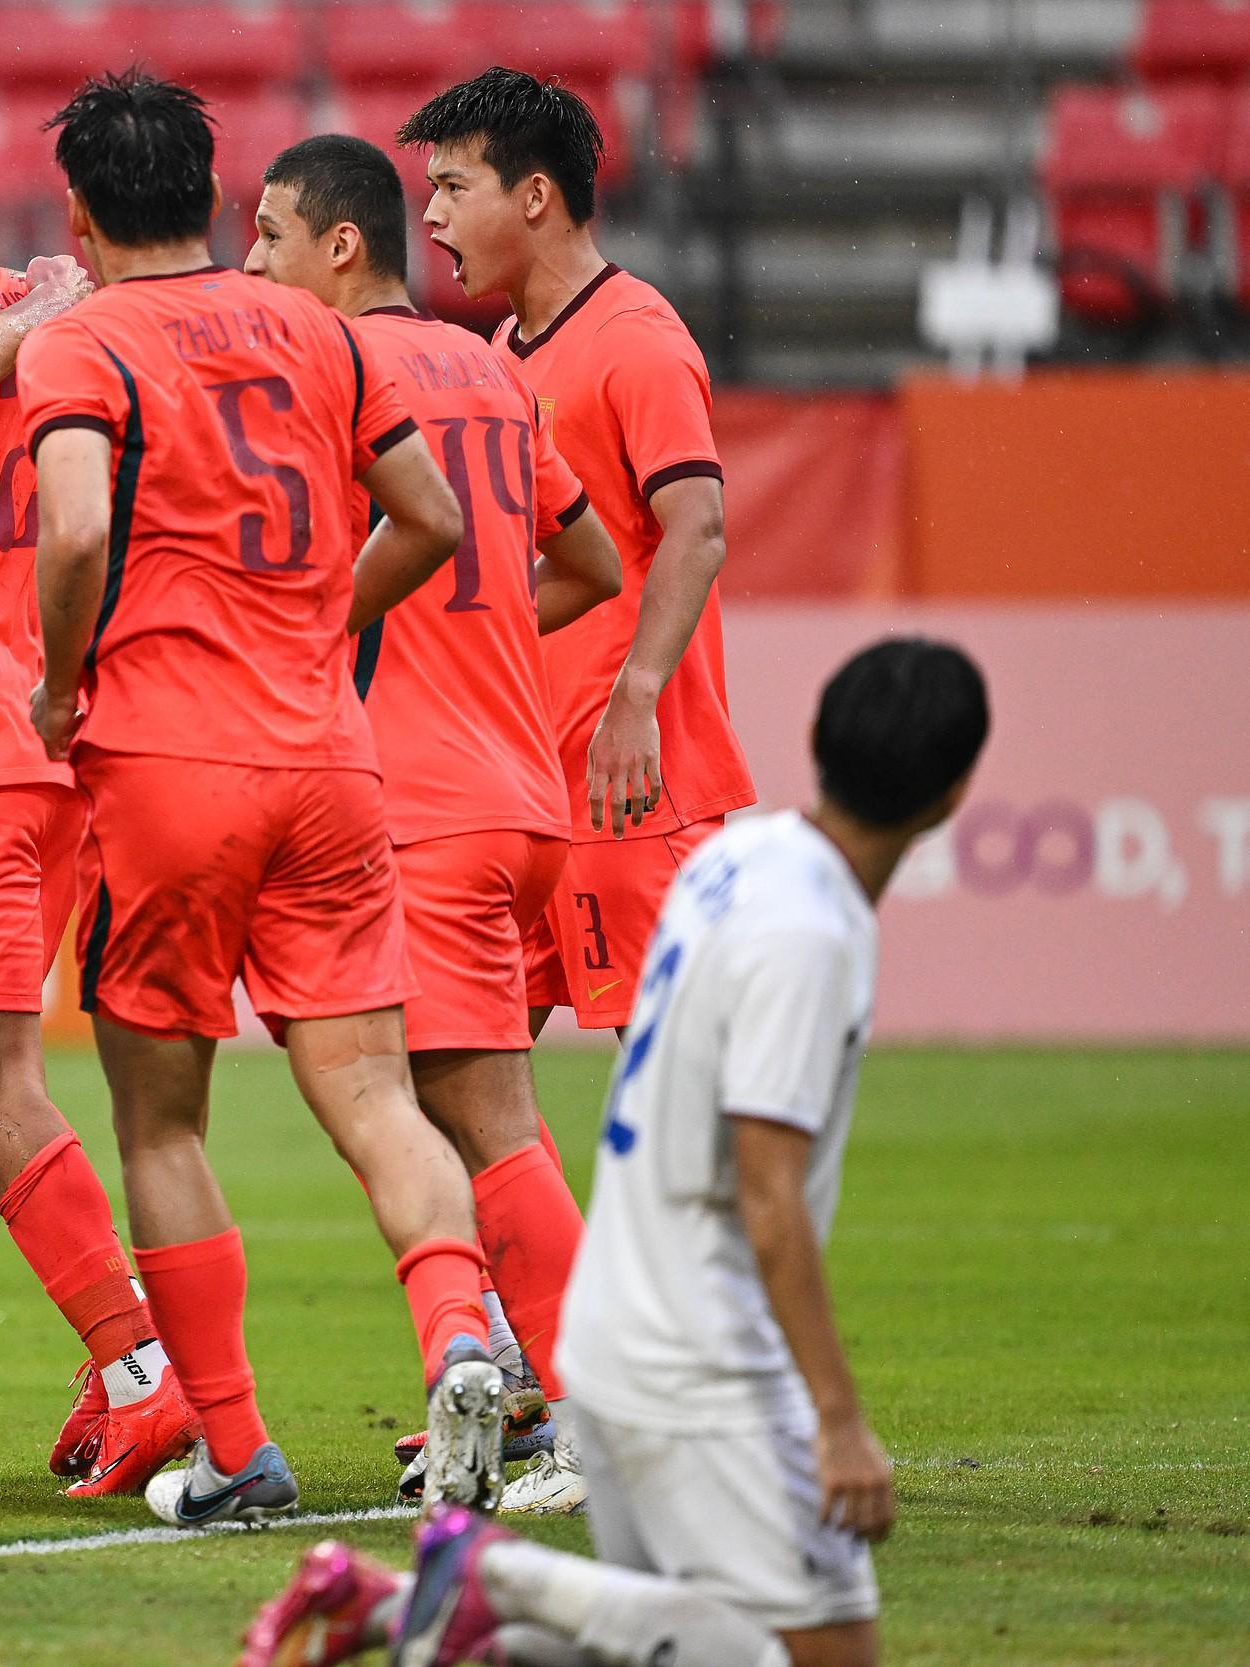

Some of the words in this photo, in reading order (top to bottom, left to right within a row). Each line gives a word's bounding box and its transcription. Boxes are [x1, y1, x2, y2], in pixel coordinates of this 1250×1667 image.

[163, 311, 232, 361] ZHU
[202, 374, 320, 572] 5
[426, 416, 539, 615] 14
[572, 891, 615, 971] 3
